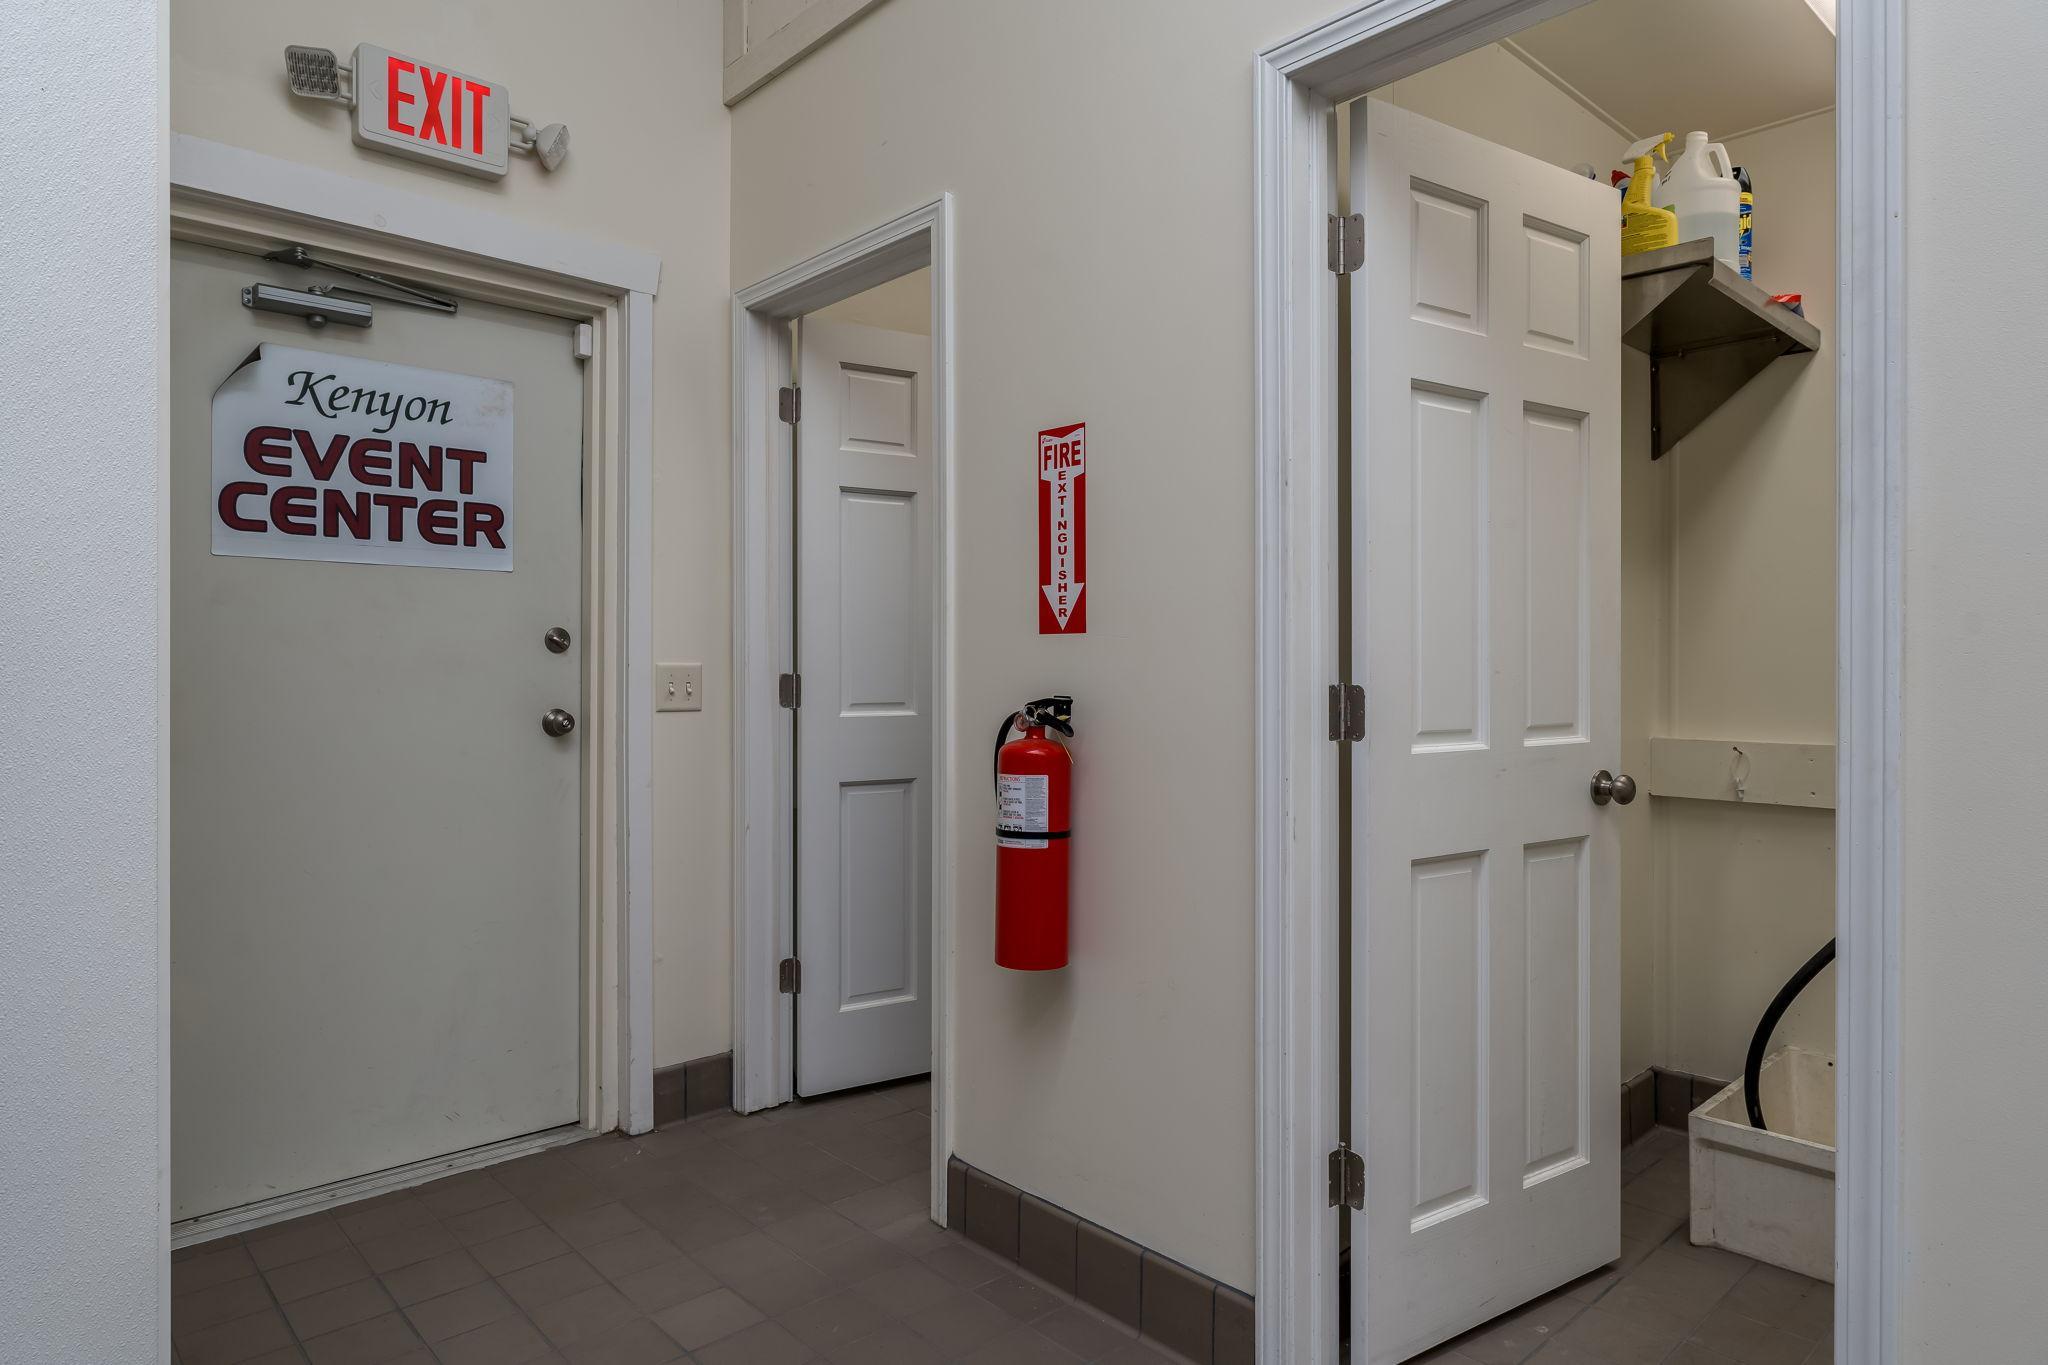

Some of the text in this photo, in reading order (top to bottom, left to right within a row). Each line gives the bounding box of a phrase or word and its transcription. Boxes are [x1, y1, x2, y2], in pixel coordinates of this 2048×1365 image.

[387, 56, 491, 155] EXIT
[284, 371, 453, 433] Kenyon
[243, 425, 488, 495] EVENT
[1043, 440, 1081, 471] FIRE
[217, 481, 507, 550] CENTER
[1057, 470, 1068, 618] EXTINGUISHER
